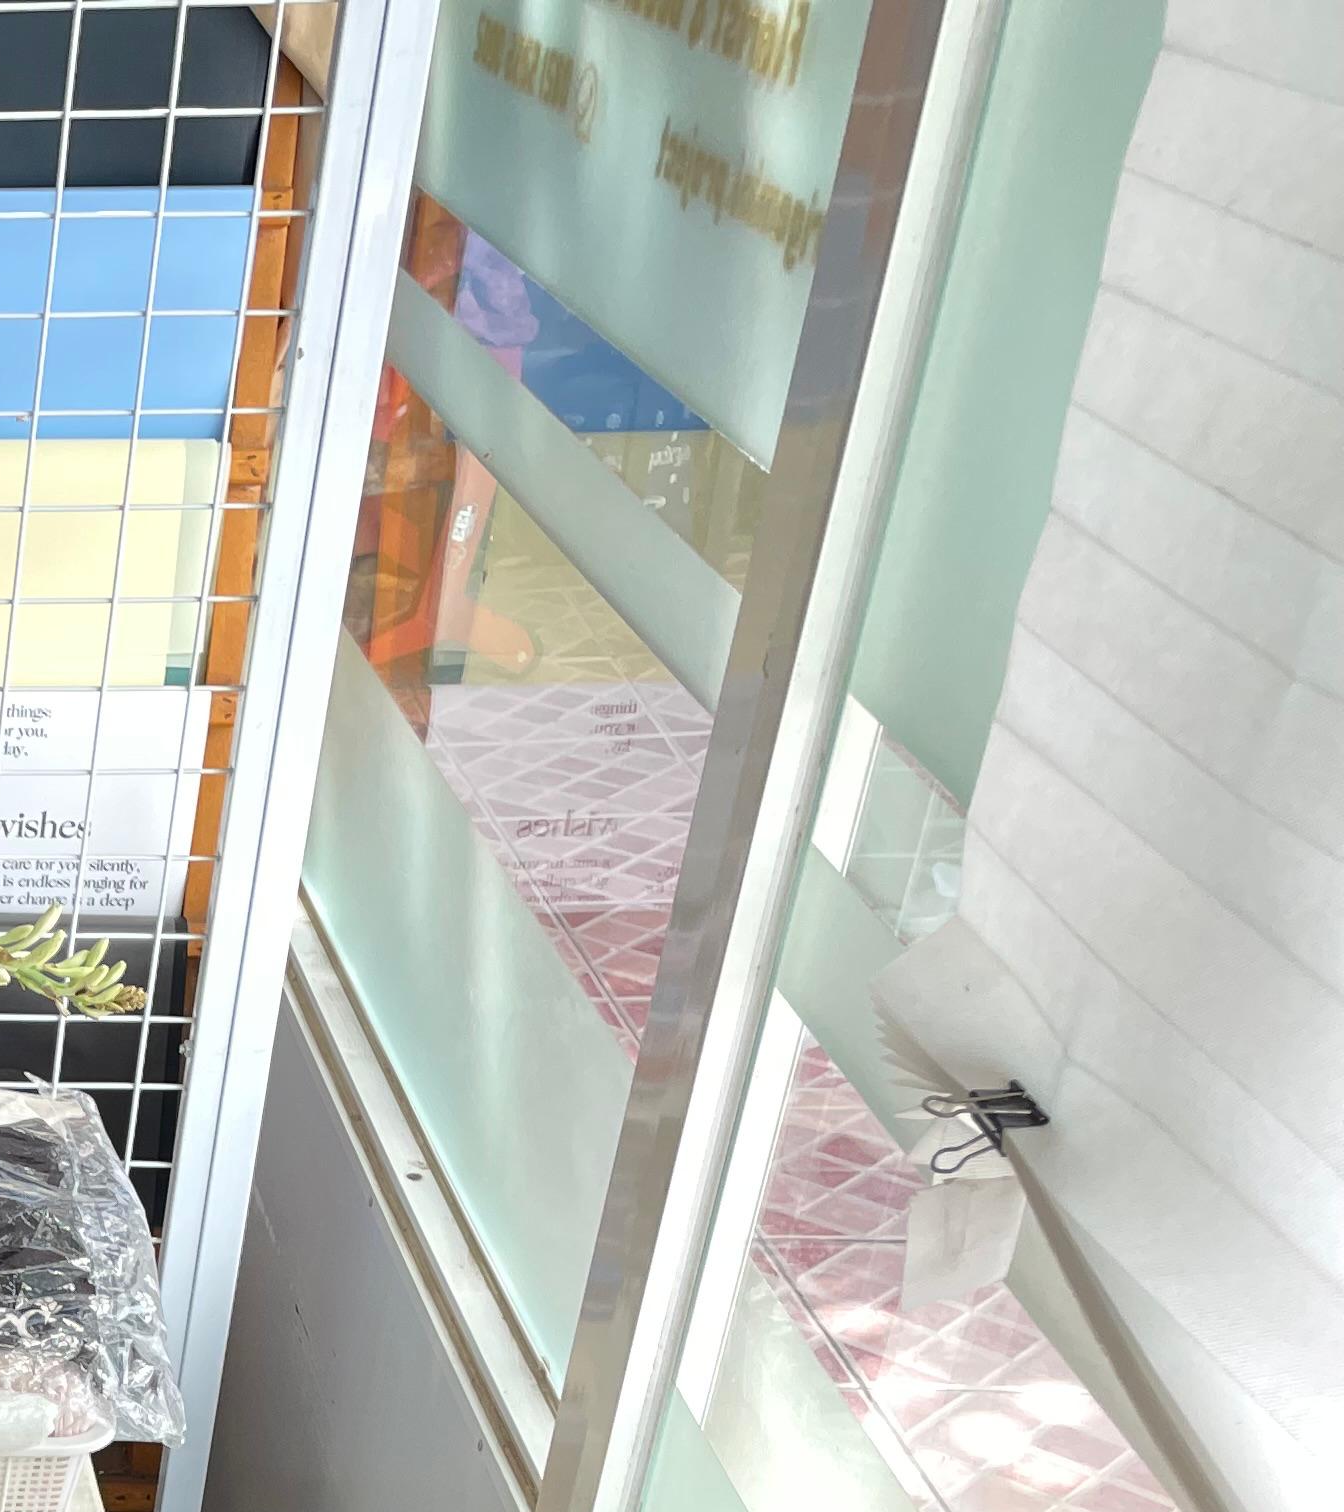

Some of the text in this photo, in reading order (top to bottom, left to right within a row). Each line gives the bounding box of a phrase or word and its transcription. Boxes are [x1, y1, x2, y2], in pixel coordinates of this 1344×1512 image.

[2, 860, 32, 871] care
[18, 875, 71, 889] endless
[129, 876, 149, 890] for
[99, 893, 136, 910] deep
